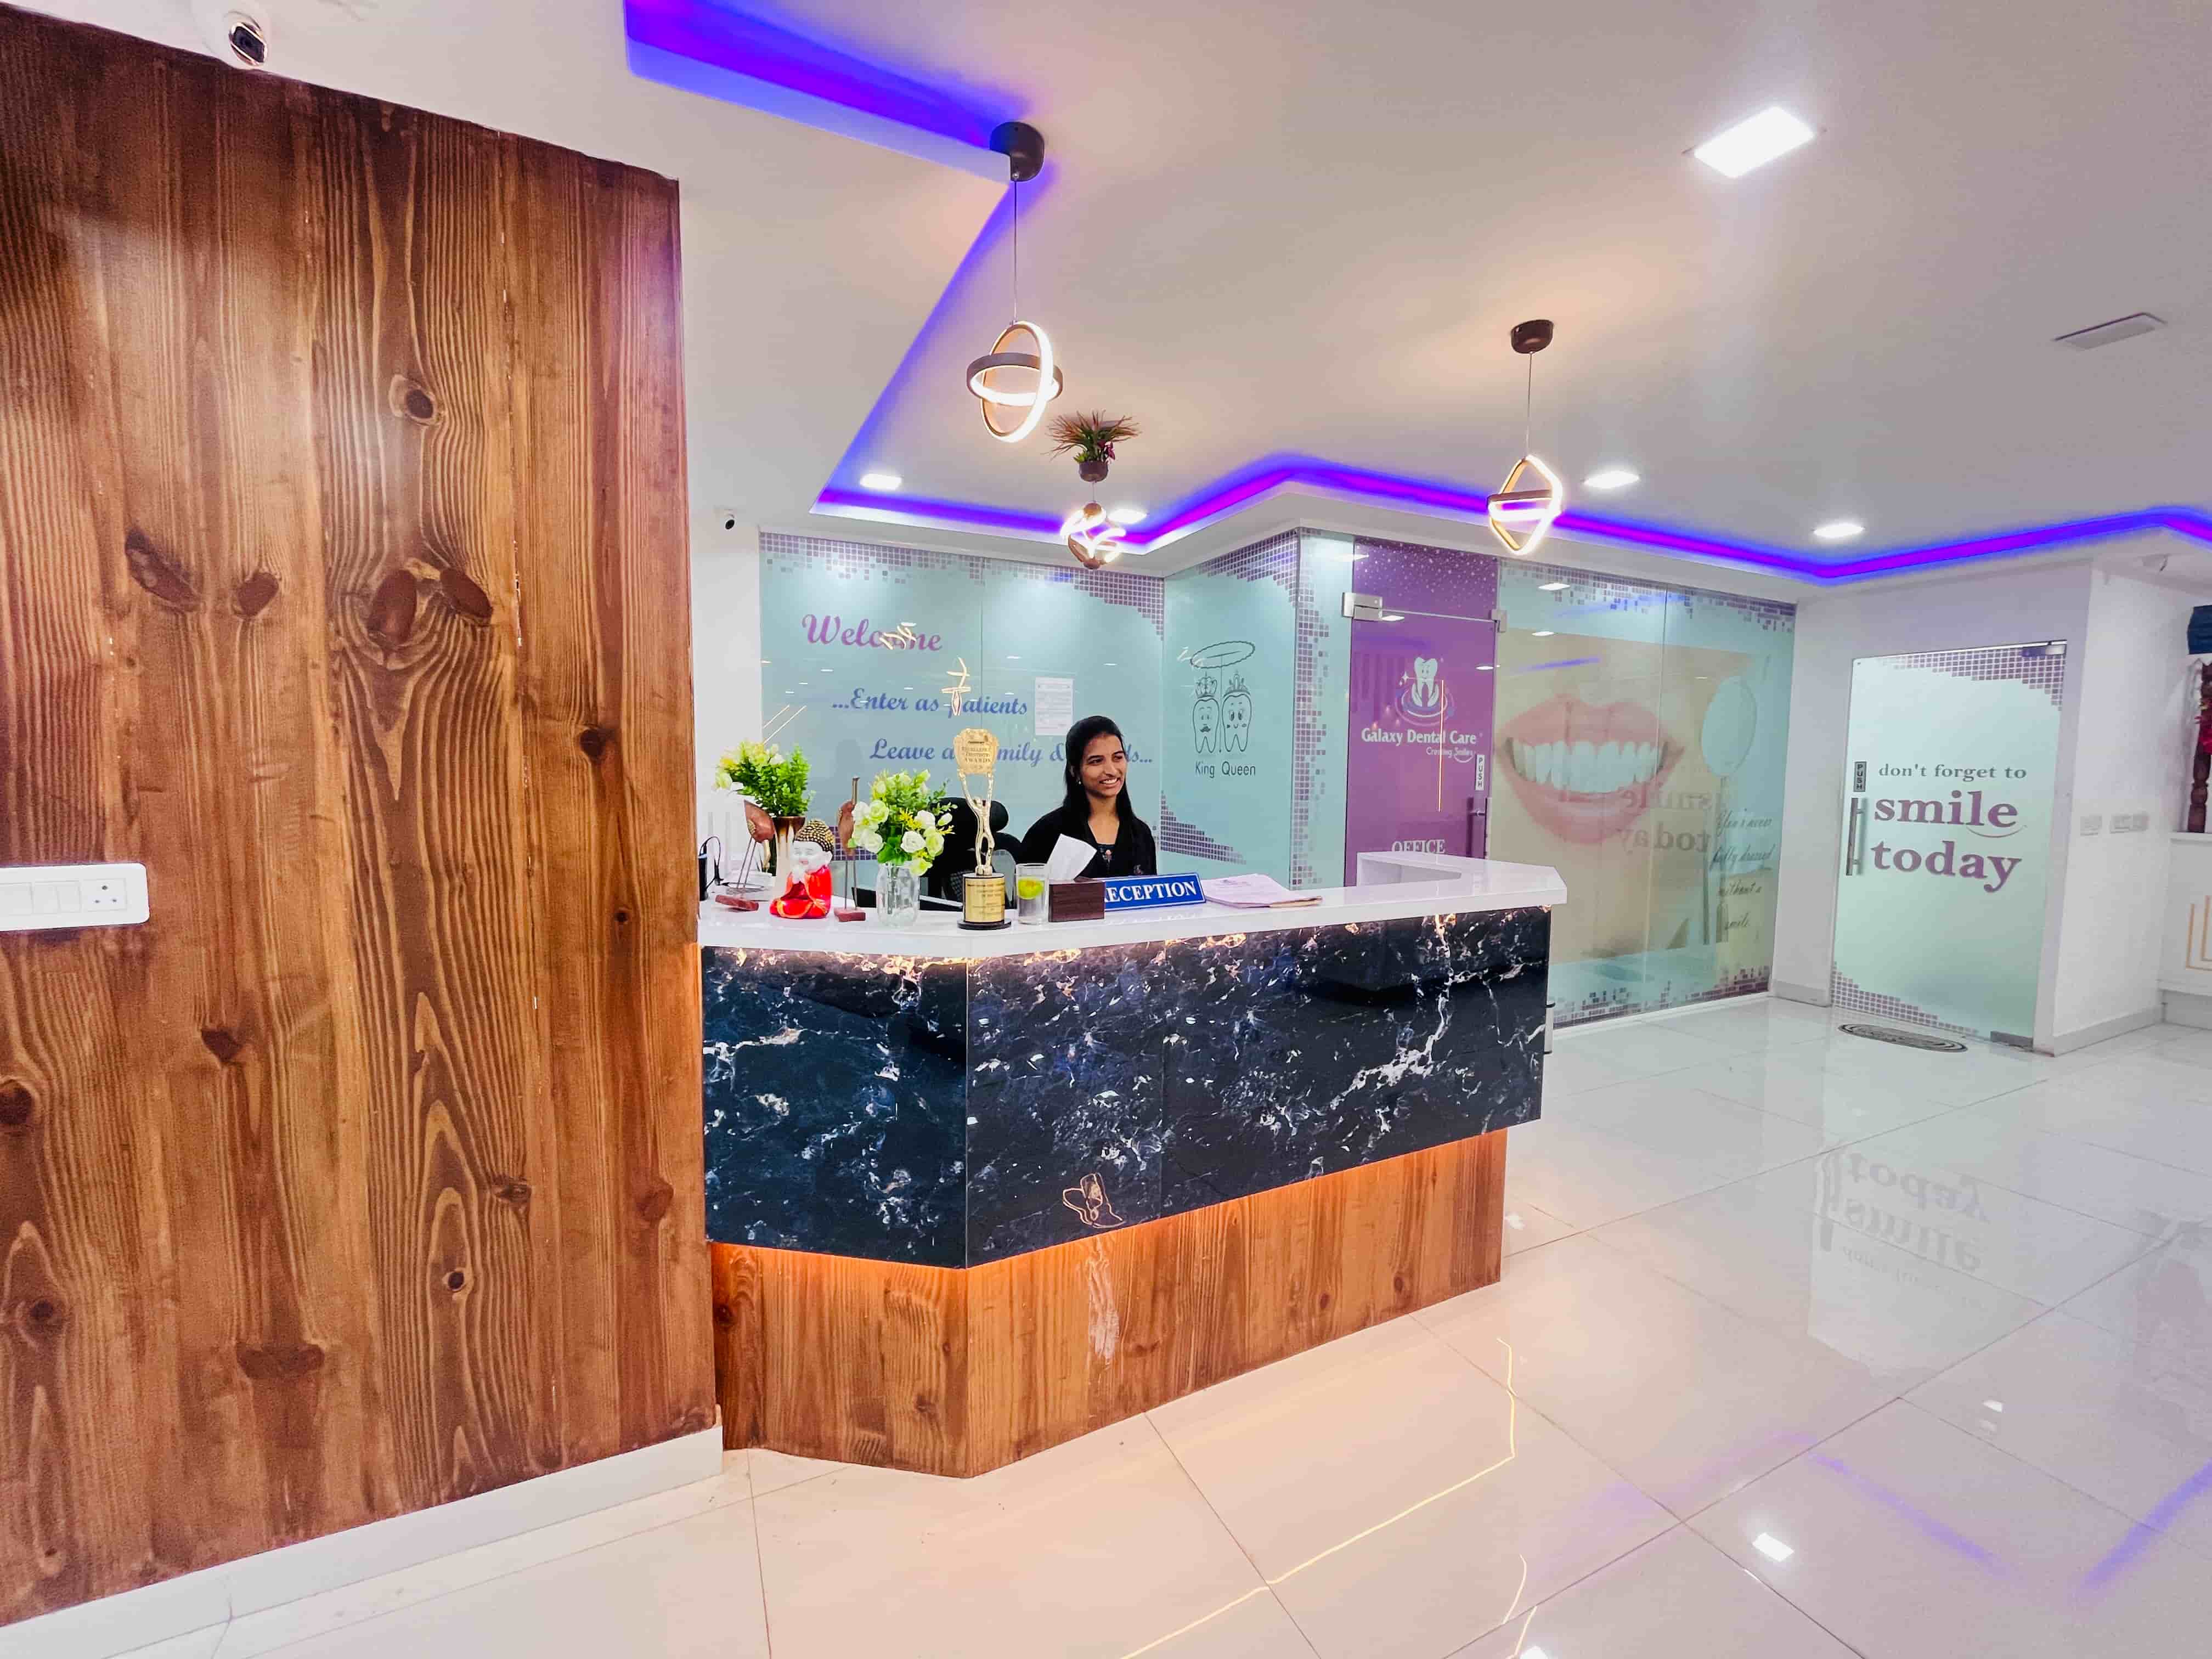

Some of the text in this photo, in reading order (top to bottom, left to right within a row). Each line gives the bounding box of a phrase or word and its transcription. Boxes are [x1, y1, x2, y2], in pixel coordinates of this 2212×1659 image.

[915, 697, 939, 712] as
[1361, 727, 1477, 747] Galaxy Dental Care
[870, 738, 935, 760] Leave
[1195, 761, 1256, 778] King Queen
[1855, 764, 1864, 791] PUSH
[1878, 763, 2027, 783] don't forget to
[1874, 790, 2018, 828] smile
[1391, 839, 1446, 854] OFFICE
[1870, 840, 2023, 893] today
[1104, 881, 1197, 902] ECEPTION
